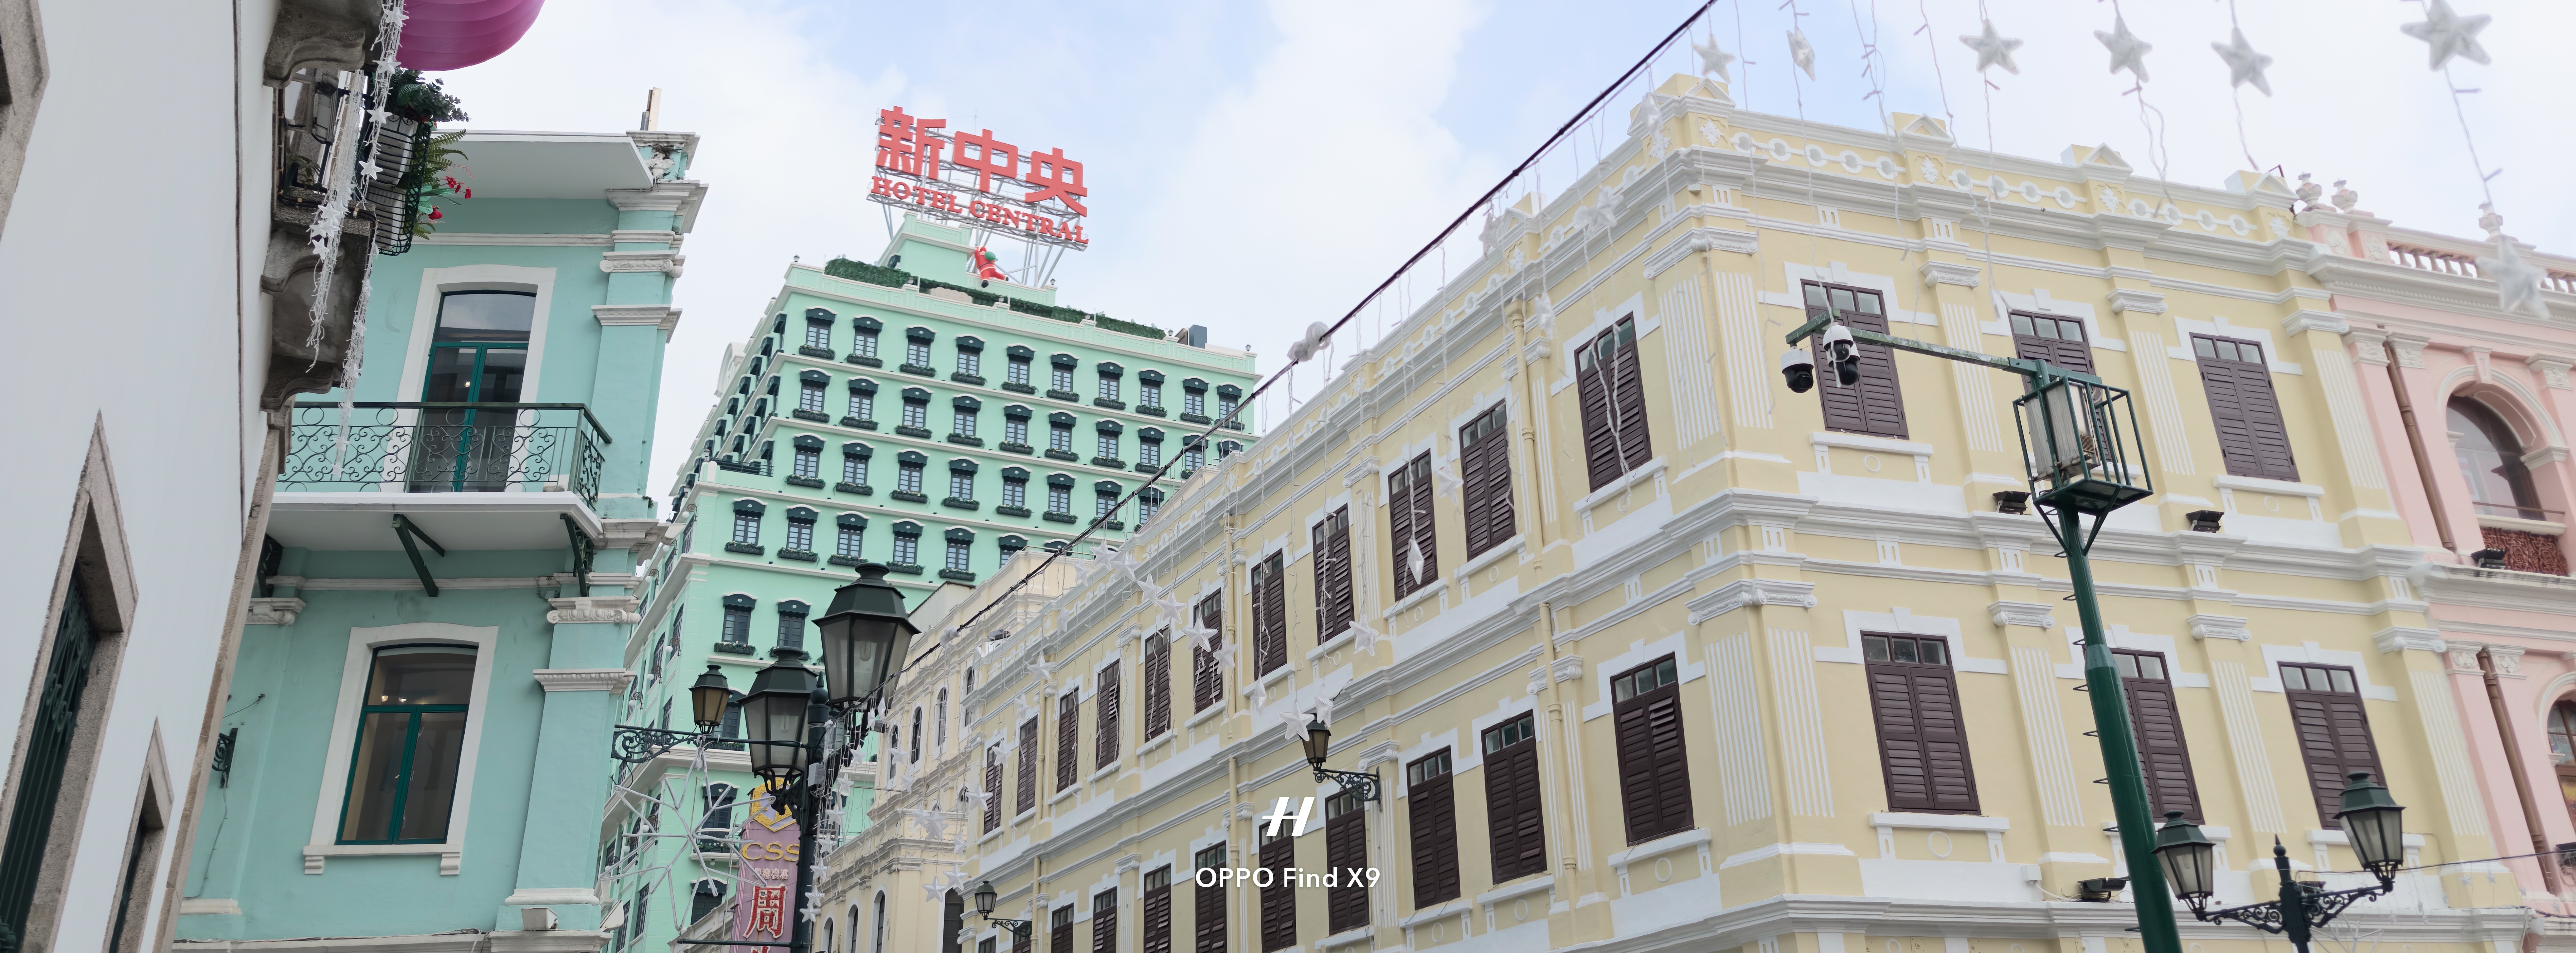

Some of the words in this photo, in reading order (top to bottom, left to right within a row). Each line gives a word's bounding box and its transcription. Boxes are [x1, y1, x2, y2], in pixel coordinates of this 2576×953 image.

[876, 106, 1087, 217] 新中央
[870, 176, 963, 213] HOTEL
[969, 200, 1089, 244] CENTRAL
[742, 842, 799, 861] CSS
[743, 883, 788, 953] 周
